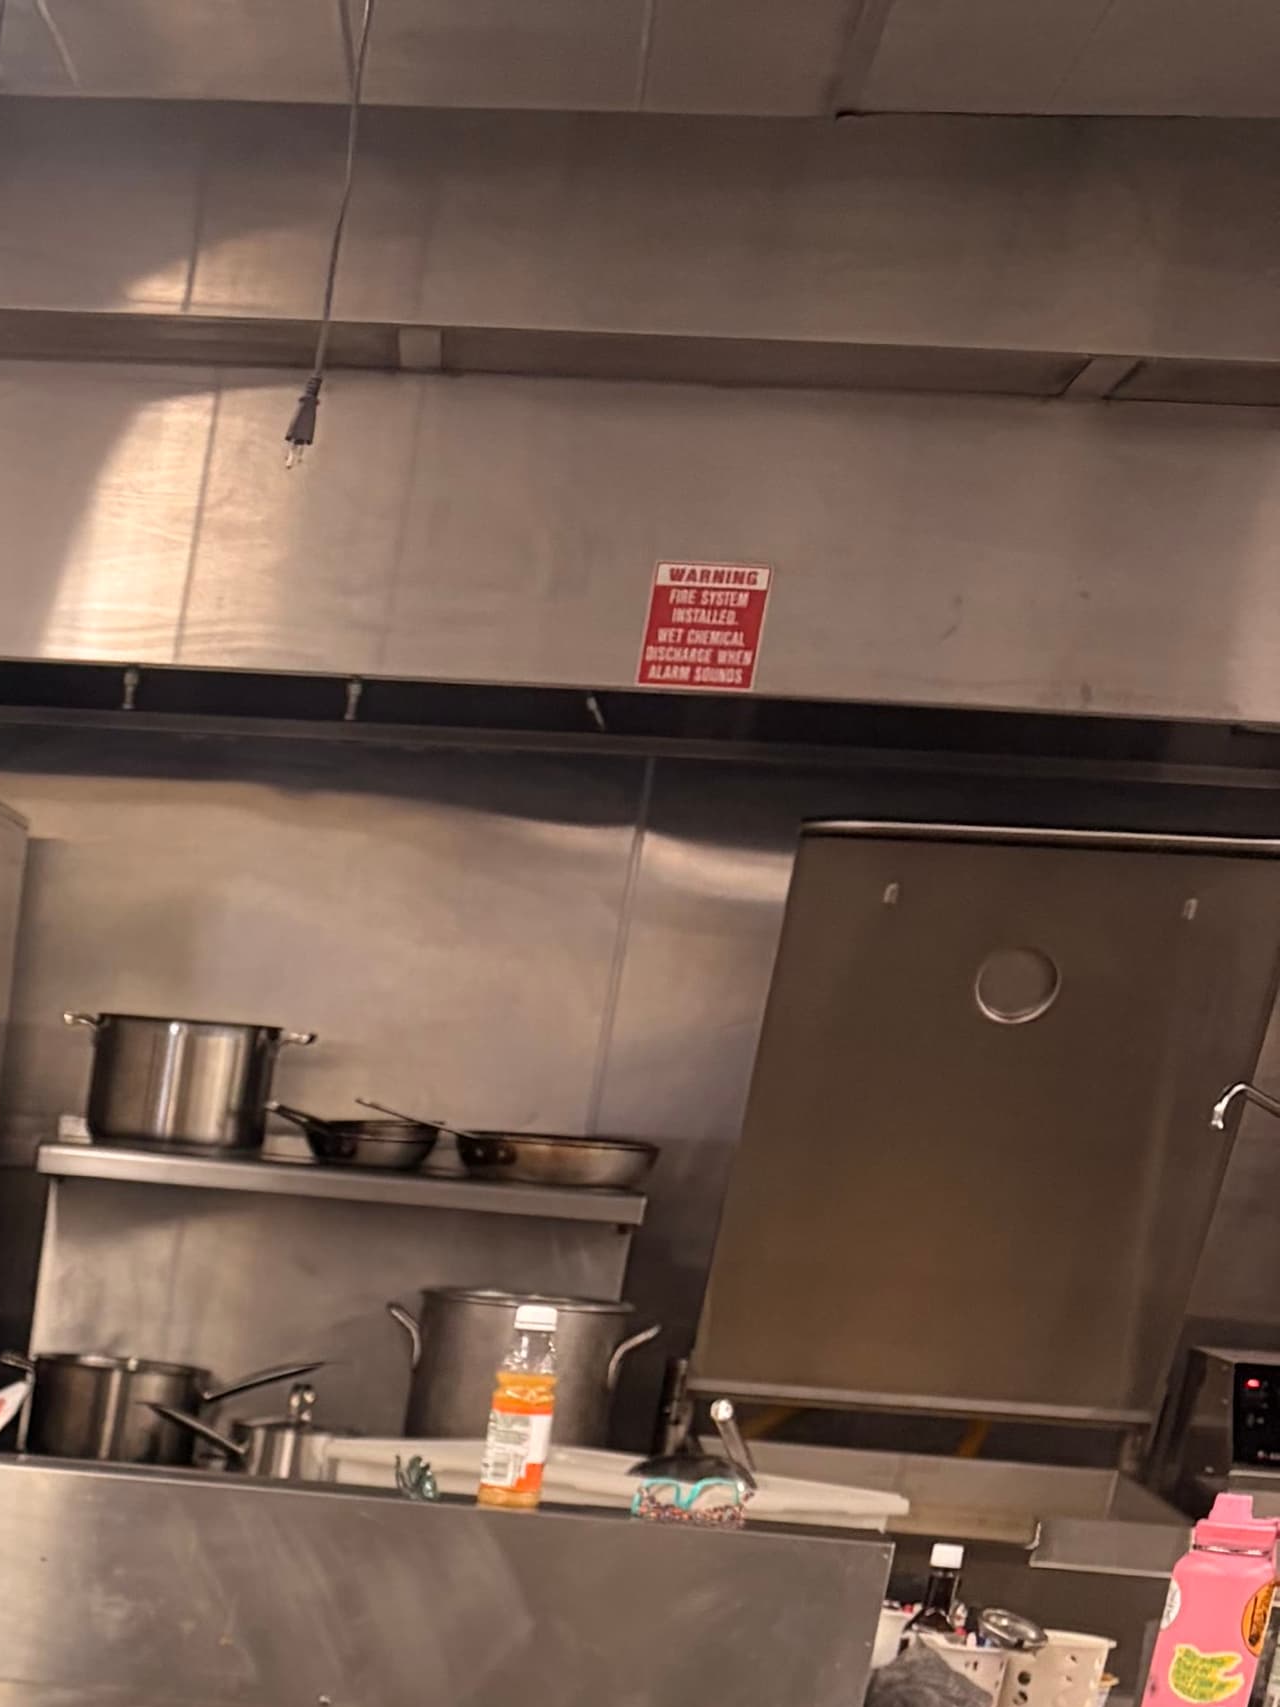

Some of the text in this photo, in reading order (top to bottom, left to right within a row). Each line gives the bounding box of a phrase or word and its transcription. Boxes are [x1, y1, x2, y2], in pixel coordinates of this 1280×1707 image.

[669, 567, 760, 585] WARNING
[669, 589, 750, 608] FIRE SYSTEM
[657, 628, 745, 647] WET CHEMICAL
[645, 646, 753, 666] DISCHARGE WHEN
[648, 665, 743, 685] ALARM SOUNDS
